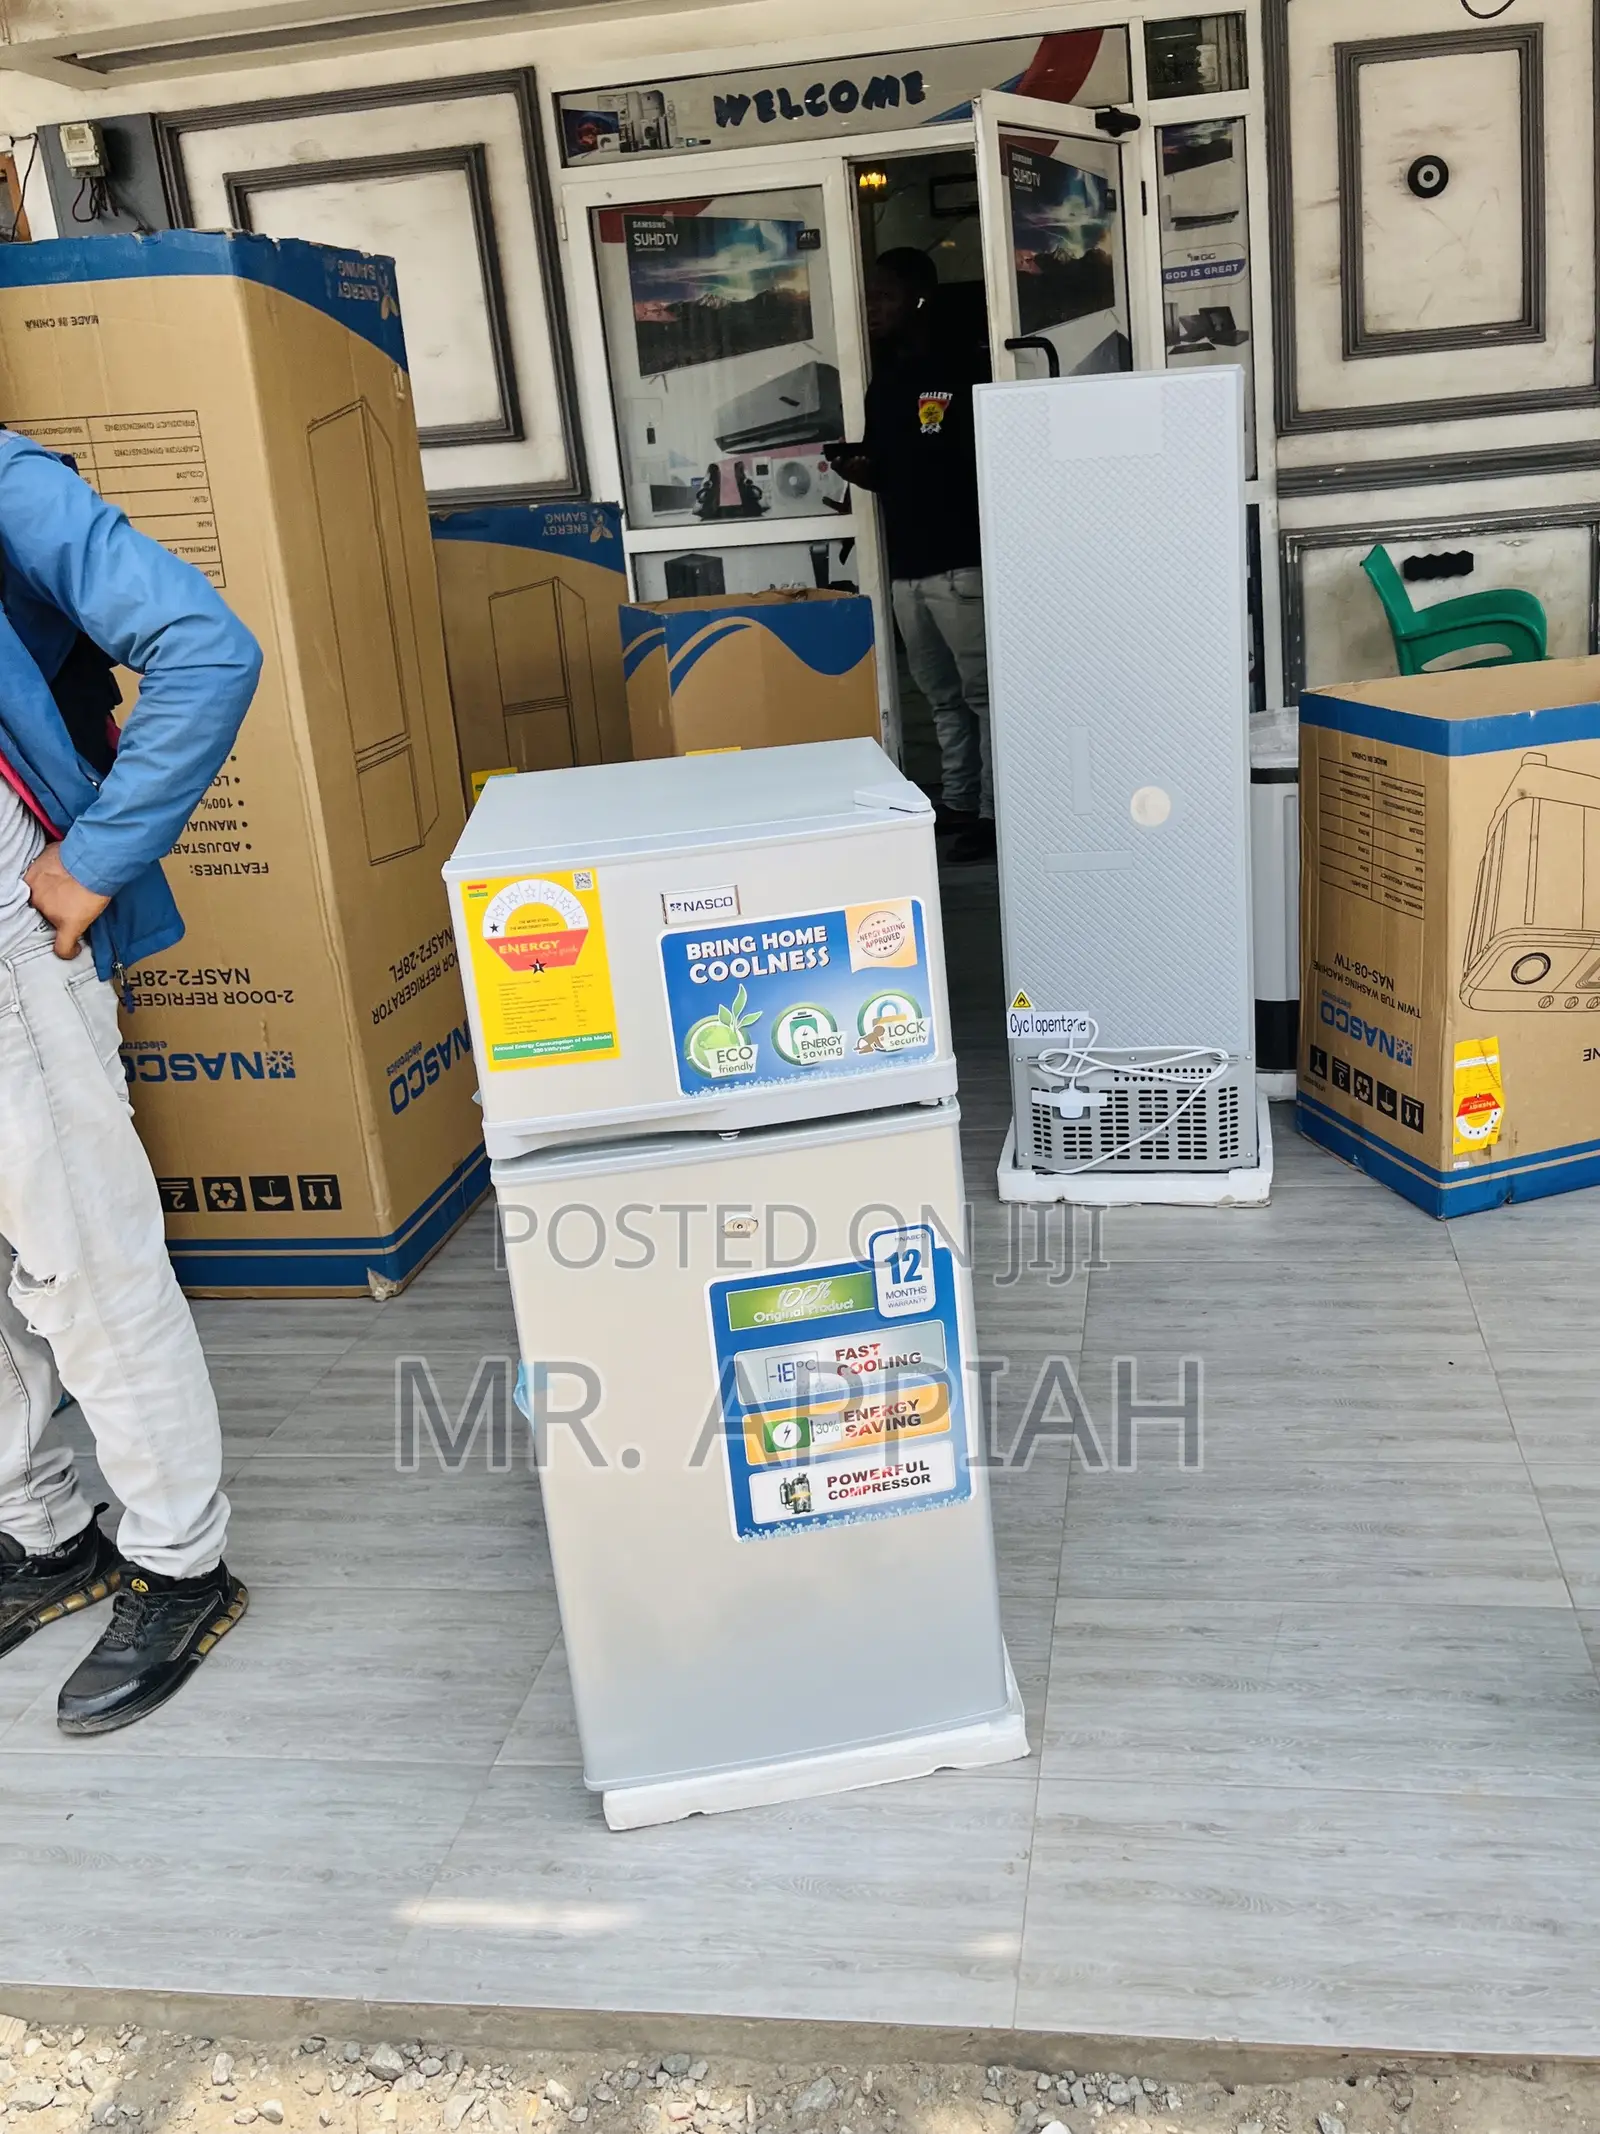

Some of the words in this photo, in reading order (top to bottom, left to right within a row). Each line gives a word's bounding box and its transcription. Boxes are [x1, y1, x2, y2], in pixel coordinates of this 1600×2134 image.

[713, 70, 926, 128] WELCOME
[632, 221, 666, 229] SAMSUNG
[633, 233, 665, 246] SUHD
[665, 233, 679, 245] TV
[1191, 269, 1200, 277] IS
[1204, 264, 1238, 275] GREAT
[24, 319, 55, 331] CHINA
[58, 317, 68, 327] IN
[70, 315, 99, 327] MADE
[545, 512, 588, 524] SAVING
[542, 524, 588, 536] ENERGY
[168, 842, 240, 854] ADJUSTAB
[189, 863, 269, 876] FEATURES:
[684, 896, 733, 912] NASCO
[499, 940, 560, 955] ENERGY
[686, 937, 756, 960] BRING
[761, 926, 828, 952] HOME
[389, 926, 453, 983] NASF2-28FL
[689, 946, 830, 984] COOLNESS
[1312, 959, 1343, 987] MACHINE
[1333, 952, 1394, 992] NAS-08-TW
[128, 968, 251, 987] NASF2-28F
[224, 989, 294, 1005] 2-DOOR
[372, 960, 442, 1025] REFRIGERATOR
[1345, 976, 1379, 1002] WASHING
[1380, 993, 1396, 1009] TUB
[1397, 1000, 1421, 1019] TWIN
[888, 1022, 926, 1038] LOCK
[1320, 1001, 1395, 1059] NASCO
[535, 1038, 574, 1047] Consumption
[801, 1034, 842, 1050] ENERGY
[890, 1034, 927, 1047] security
[386, 1041, 422, 1077] electronics
[716, 1046, 753, 1064] ECO
[389, 1019, 471, 1115] NASCO
[718, 1062, 754, 1074] friendly
[1338, 1071, 1344, 1087] 3
[171, 1193, 186, 1209] 2
[884, 1249, 922, 1285] 12
[778, 1280, 832, 1309] 100%
[885, 1285, 927, 1300] MONTHS
[754, 1307, 804, 1323] Original
[809, 1298, 854, 1315] Product
[888, 1297, 927, 1308] WARRANTY
[835, 1343, 881, 1362] FAST
[837, 1352, 922, 1377] COOLING
[844, 1399, 919, 1423] ENERGY
[816, 1420, 839, 1434] 30%
[846, 1414, 921, 1438] SAVING
[826, 1460, 930, 1488] POWERFUL
[828, 1473, 931, 1501] COMPRESSOR
